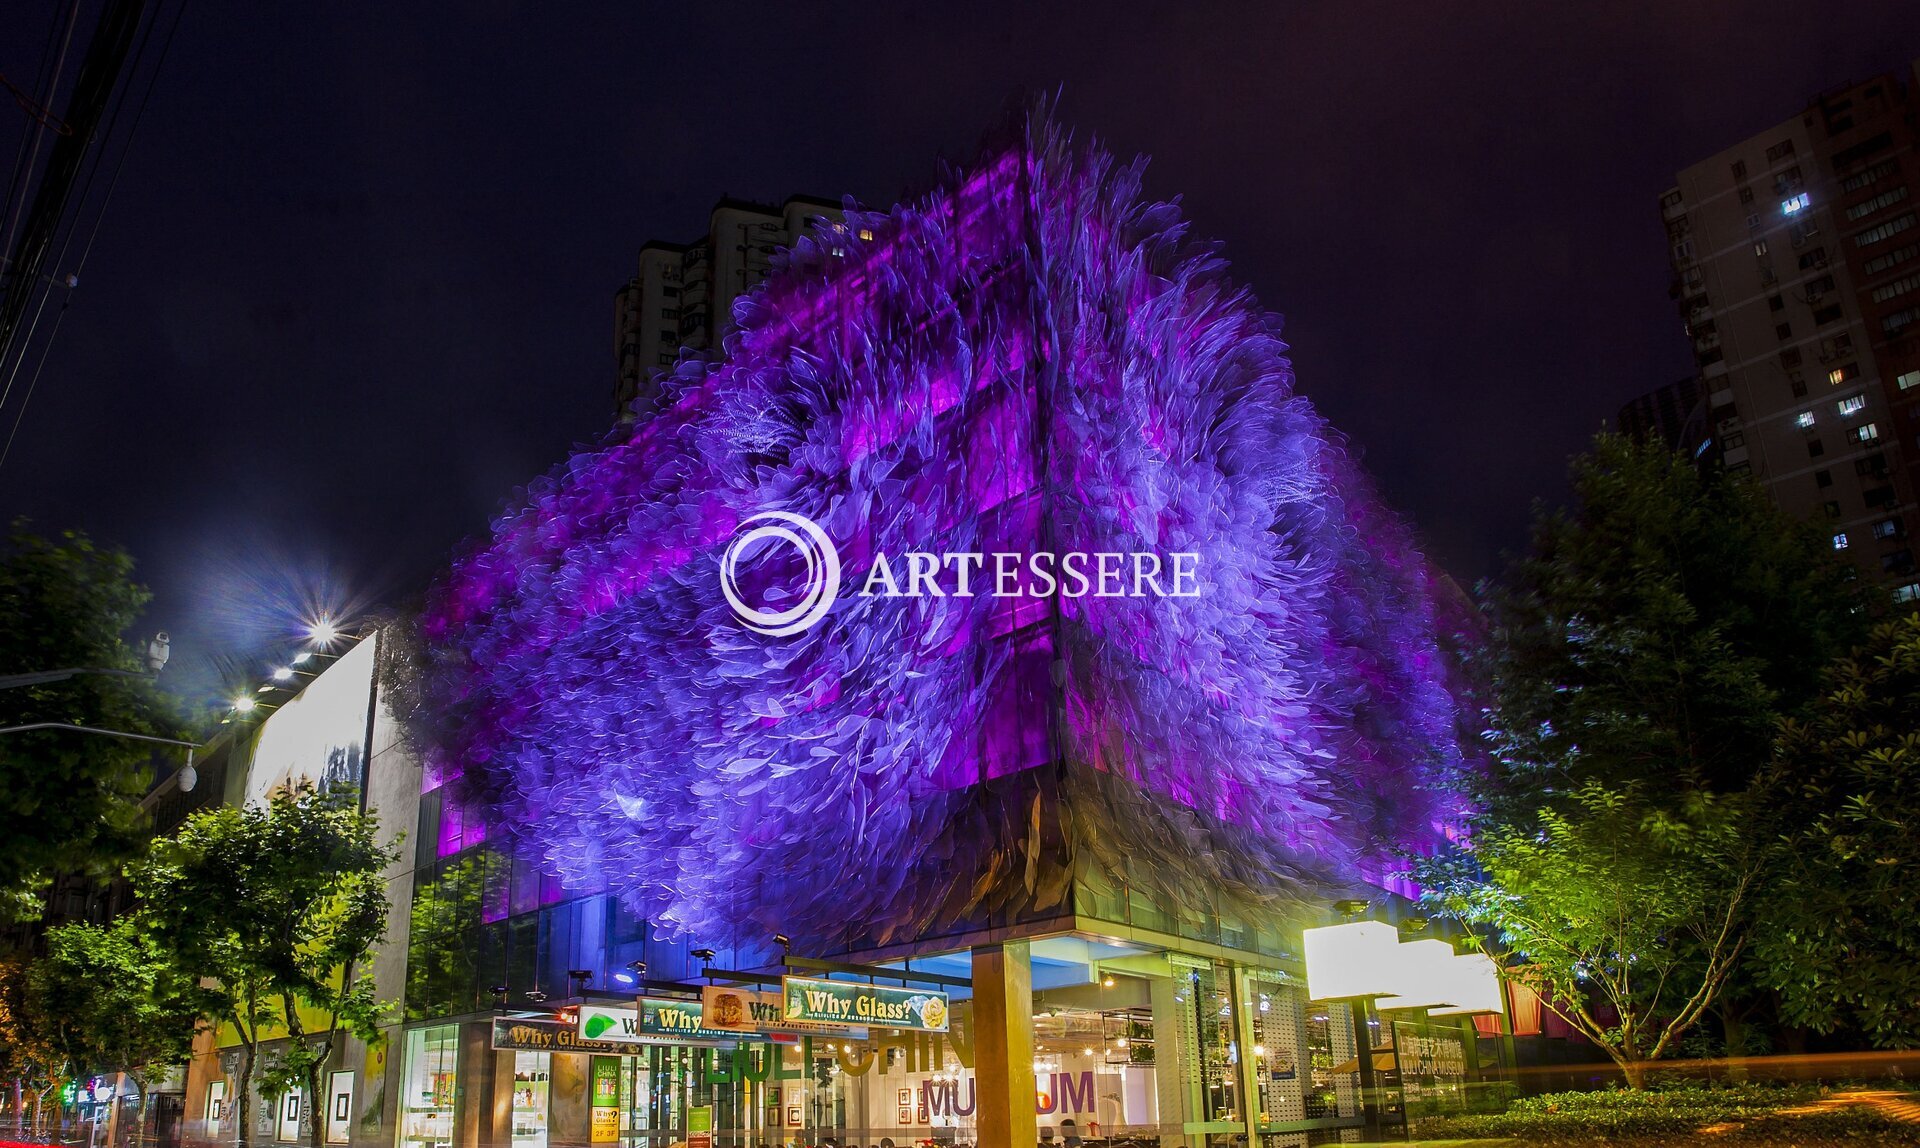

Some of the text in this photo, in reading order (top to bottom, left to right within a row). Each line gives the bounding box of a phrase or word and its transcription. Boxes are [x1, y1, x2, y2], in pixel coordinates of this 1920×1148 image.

[748, 1001, 783, 1023] Wh
[805, 990, 851, 1020] Why
[856, 995, 911, 1021] Glass?
[658, 1008, 703, 1034] Why
[511, 1025, 552, 1048] Why
